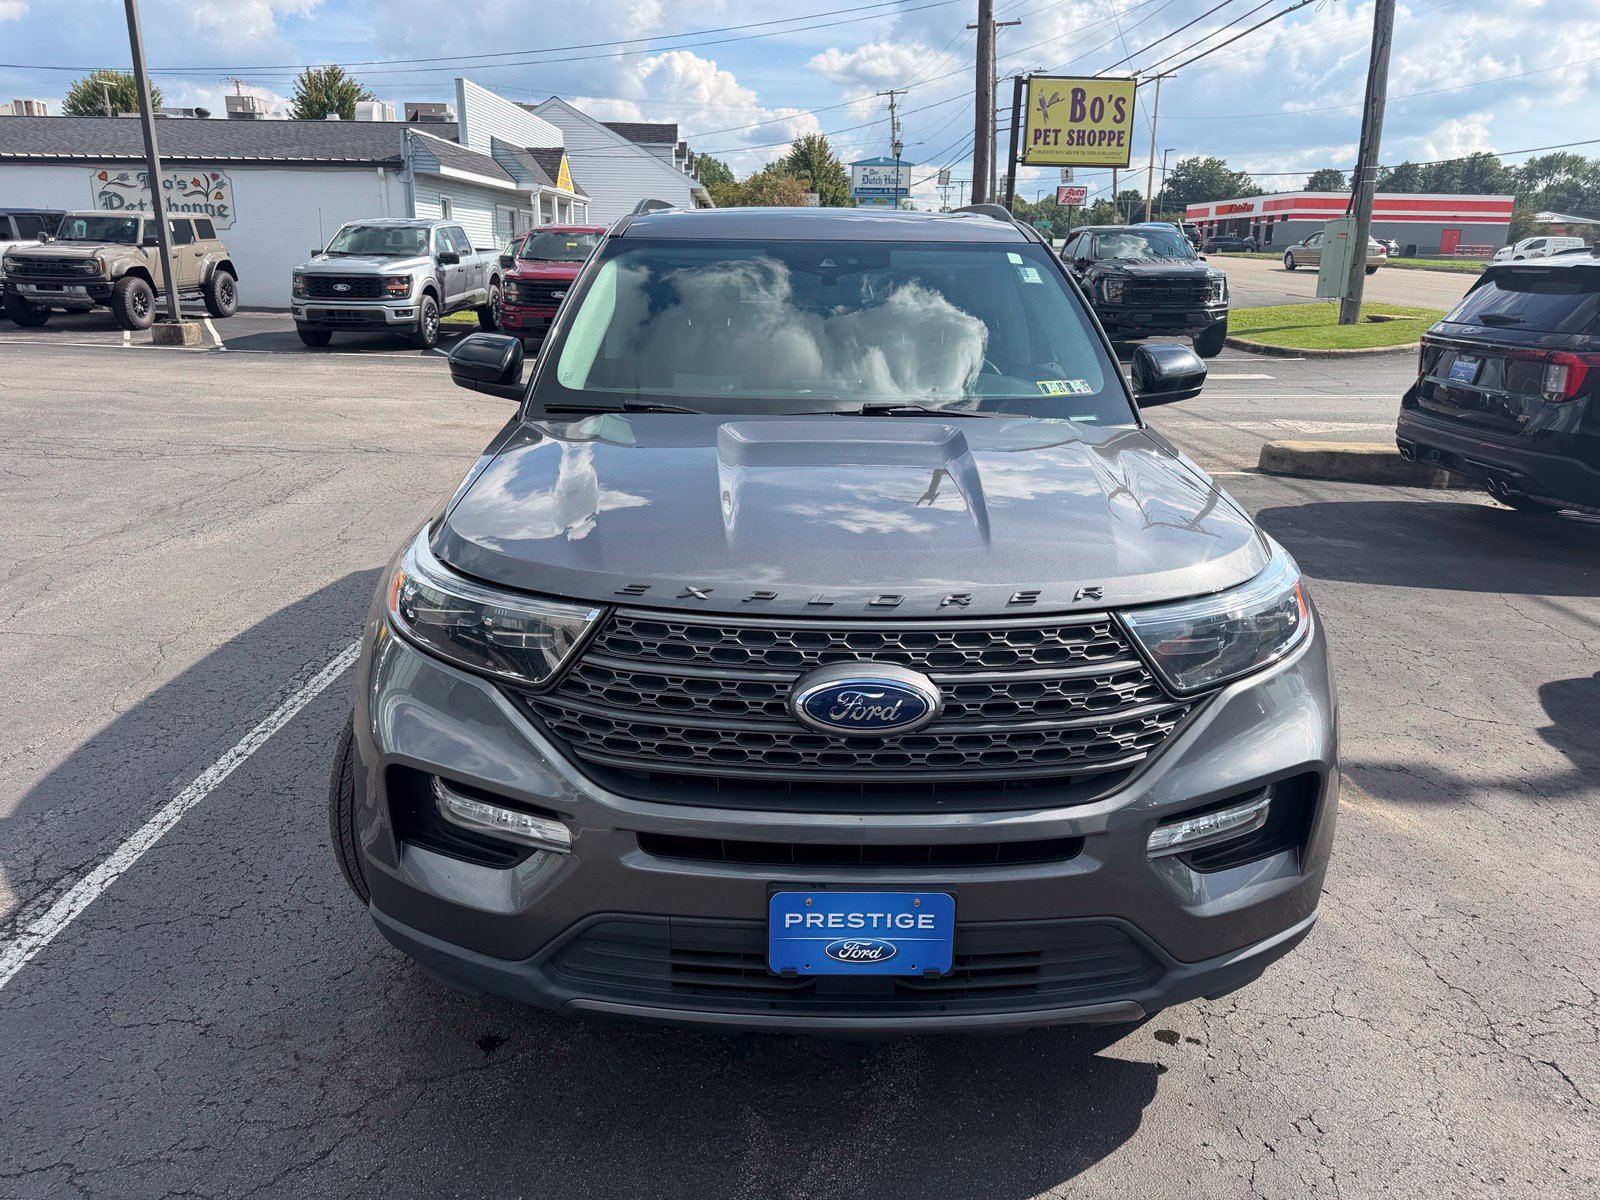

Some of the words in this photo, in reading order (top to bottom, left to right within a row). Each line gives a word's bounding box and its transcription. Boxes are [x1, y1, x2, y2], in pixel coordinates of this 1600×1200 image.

[1069, 87, 1126, 124] BO'S
[1033, 128, 1061, 146] PET
[1066, 129, 1125, 147] SHOPPE
[1454, 360, 1477, 369] PRESTIGE
[614, 585, 1104, 606] EXPLORER
[829, 690, 903, 721] Ford
[785, 913, 934, 929] PRESTIGE
[838, 940, 882, 959] Ford
